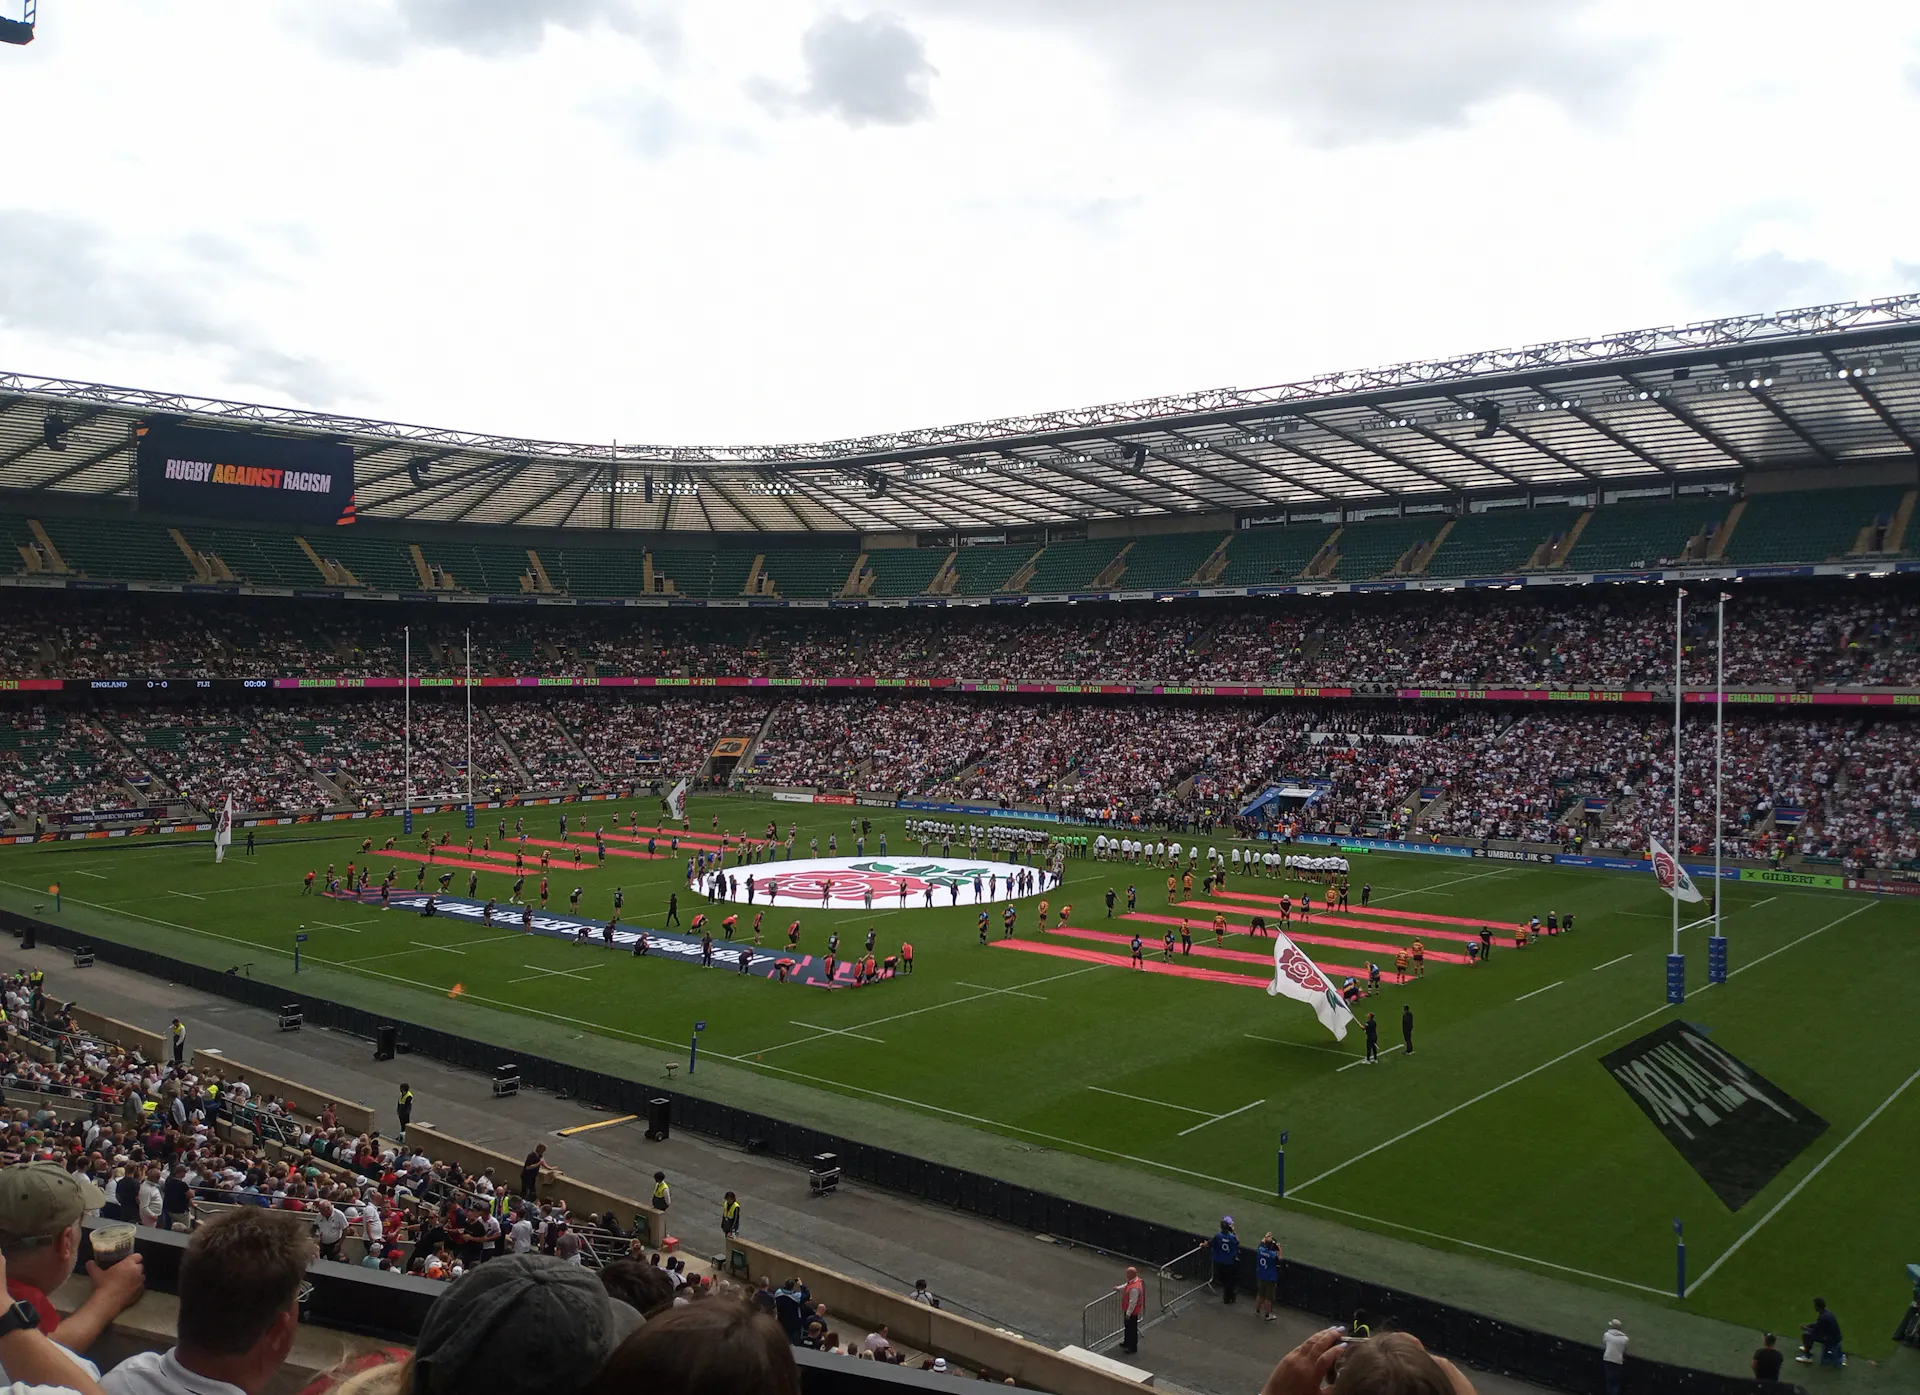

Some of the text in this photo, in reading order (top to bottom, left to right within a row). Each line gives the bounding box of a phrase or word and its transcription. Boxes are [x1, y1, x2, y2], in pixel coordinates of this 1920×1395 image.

[165, 459, 331, 493] RUGBY AGAINST RACISM
[244, 680, 266, 688] 00:00
[299, 679, 336, 687] ENGLAND
[348, 679, 364, 687] FIJI
[420, 678, 453, 686] ENGLAND
[538, 678, 573, 686] ENGLAND
[583, 678, 600, 686] FIJI
[655, 678, 690, 686] ENGLAND
[700, 678, 716, 686] FIJI
[875, 679, 906, 687] ENGLAND
[915, 679, 930, 687] FIJI
[1163, 687, 1192, 695] ENGLAND
[1200, 687, 1215, 695] FIJI
[1263, 688, 1295, 696] ENGLAND
[1304, 688, 1319, 696] FIJI
[1420, 690, 1456, 698] ENGLAND
[1468, 690, 1486, 698] FIJI
[1549, 692, 1590, 701] ENGLAND
[1603, 692, 1623, 701] FIJI
[1728, 694, 1775, 703] ENGLAND
[1790, 694, 1813, 703] FIJI
[1762, 872, 1815, 885] GILBERT
[1613, 1040, 1749, 1141] TikTok
